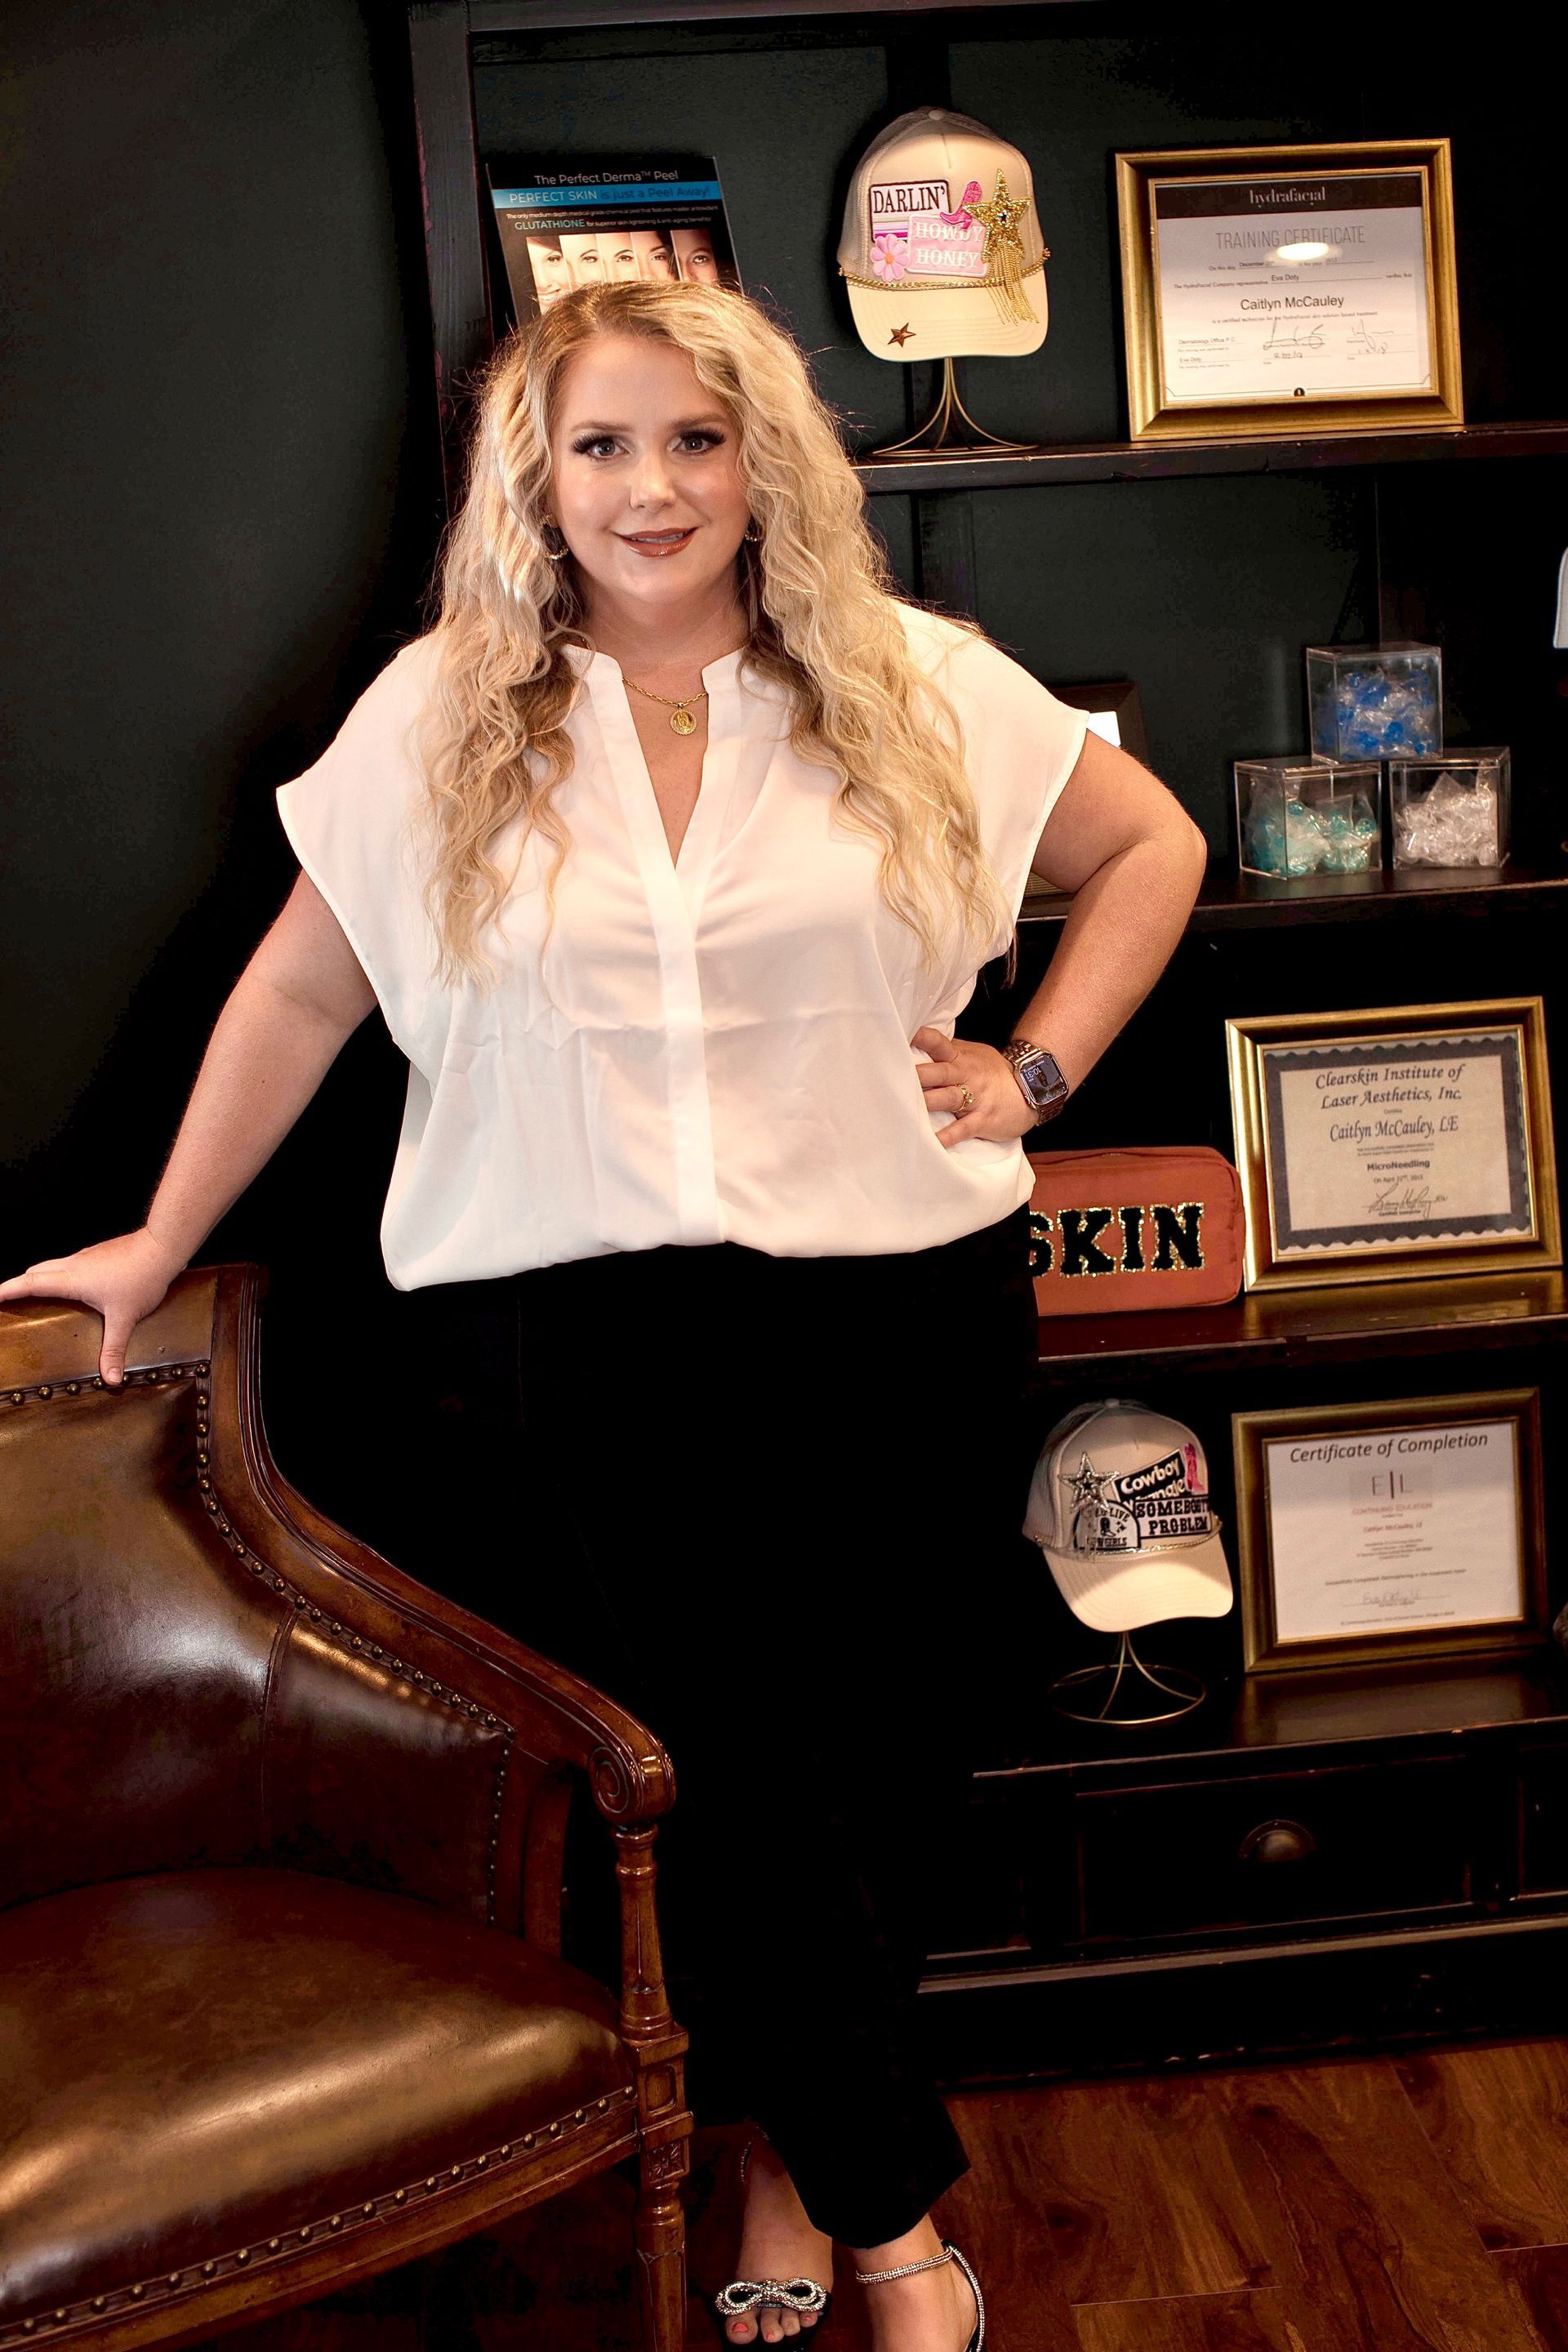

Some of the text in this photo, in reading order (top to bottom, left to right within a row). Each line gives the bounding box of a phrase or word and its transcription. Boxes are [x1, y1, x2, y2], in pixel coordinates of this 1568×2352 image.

[534, 175, 556, 185] The
[559, 172, 600, 184] Perfect
[653, 170, 679, 180] Peel
[509, 191, 564, 203] PERFECT
[568, 189, 598, 201] SKIN
[647, 187, 674, 198] Peel
[873, 185, 946, 214] DARLIN'
[1249, 186, 1327, 208] hydrafacial
[514, 219, 585, 229] GLUTATHIONE
[1215, 225, 1366, 249] TRAINING CERTIFICATE
[916, 248, 980, 268] HONEY
[1241, 295, 1345, 311] Caitlyn McCauley
[1316, 1063, 1466, 1089] Clearskin Institute of
[1321, 1086, 1463, 1110] Laser Aesthetics, Inc.
[1330, 1115, 1459, 1143] Caitlyn McCauley, LE
[1367, 1159, 1431, 1171] MicroNeedling
[1290, 1432, 1489, 1463] Certificate of Completion
[1120, 1458, 1181, 1494] Cowboy
[1149, 1516, 1208, 1535] PROBLEM
[1086, 1537, 1127, 1548] WGIRLS
